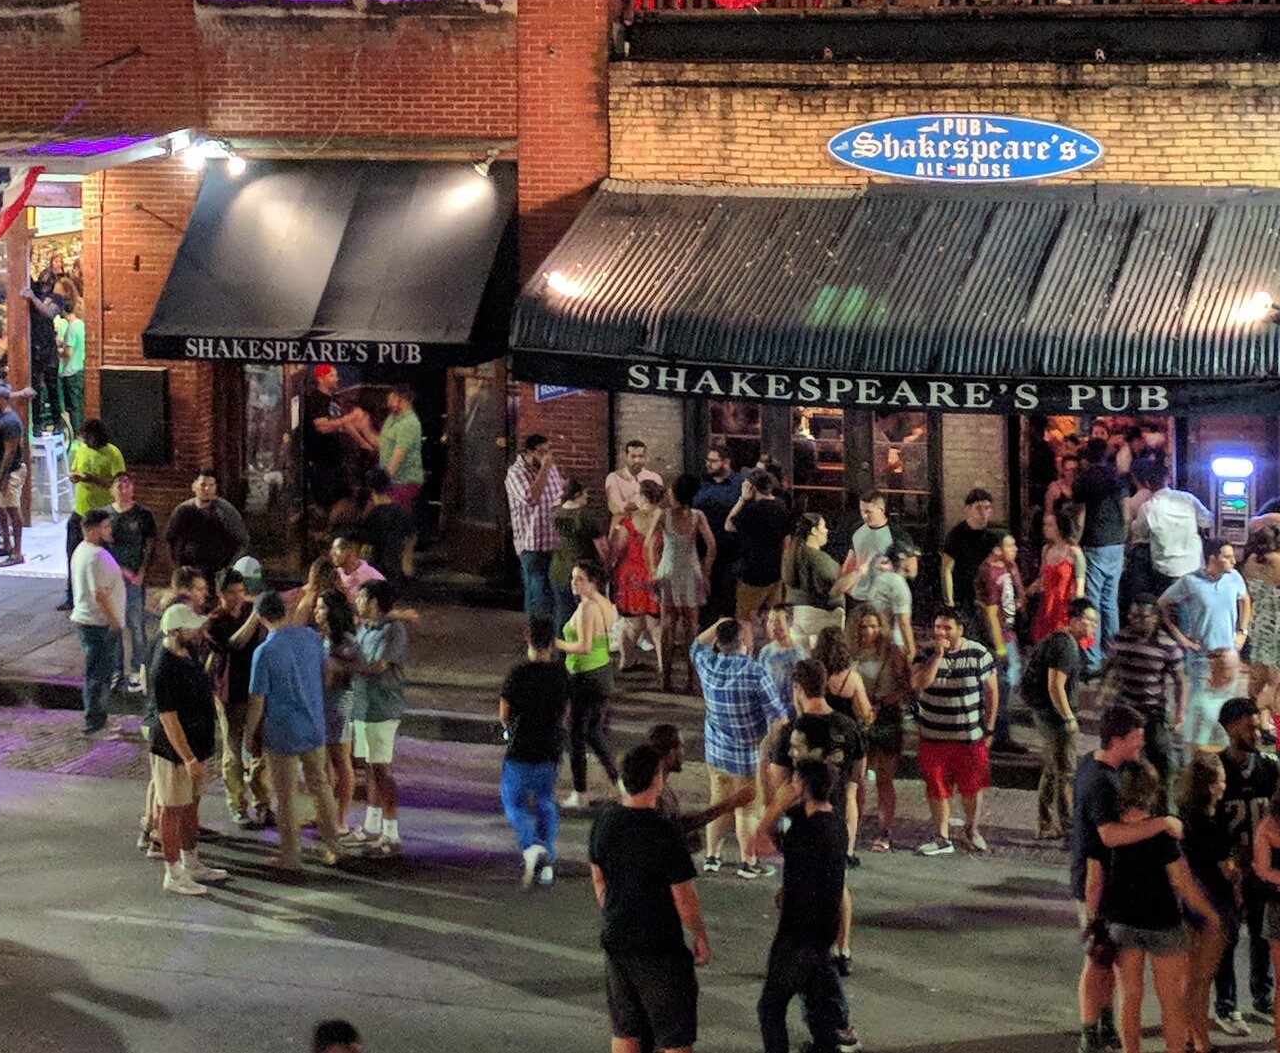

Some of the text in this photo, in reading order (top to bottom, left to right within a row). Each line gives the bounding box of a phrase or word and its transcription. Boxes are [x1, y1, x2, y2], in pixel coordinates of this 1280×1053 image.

[943, 118, 981, 136] PUB
[852, 131, 1077, 164] Shakespeare's
[915, 162, 1011, 177] ALE HOUSE
[185, 337, 422, 364] SHAKESPEARE'S PUB
[627, 364, 1170, 412] SHAKESPEARE'S PUB
